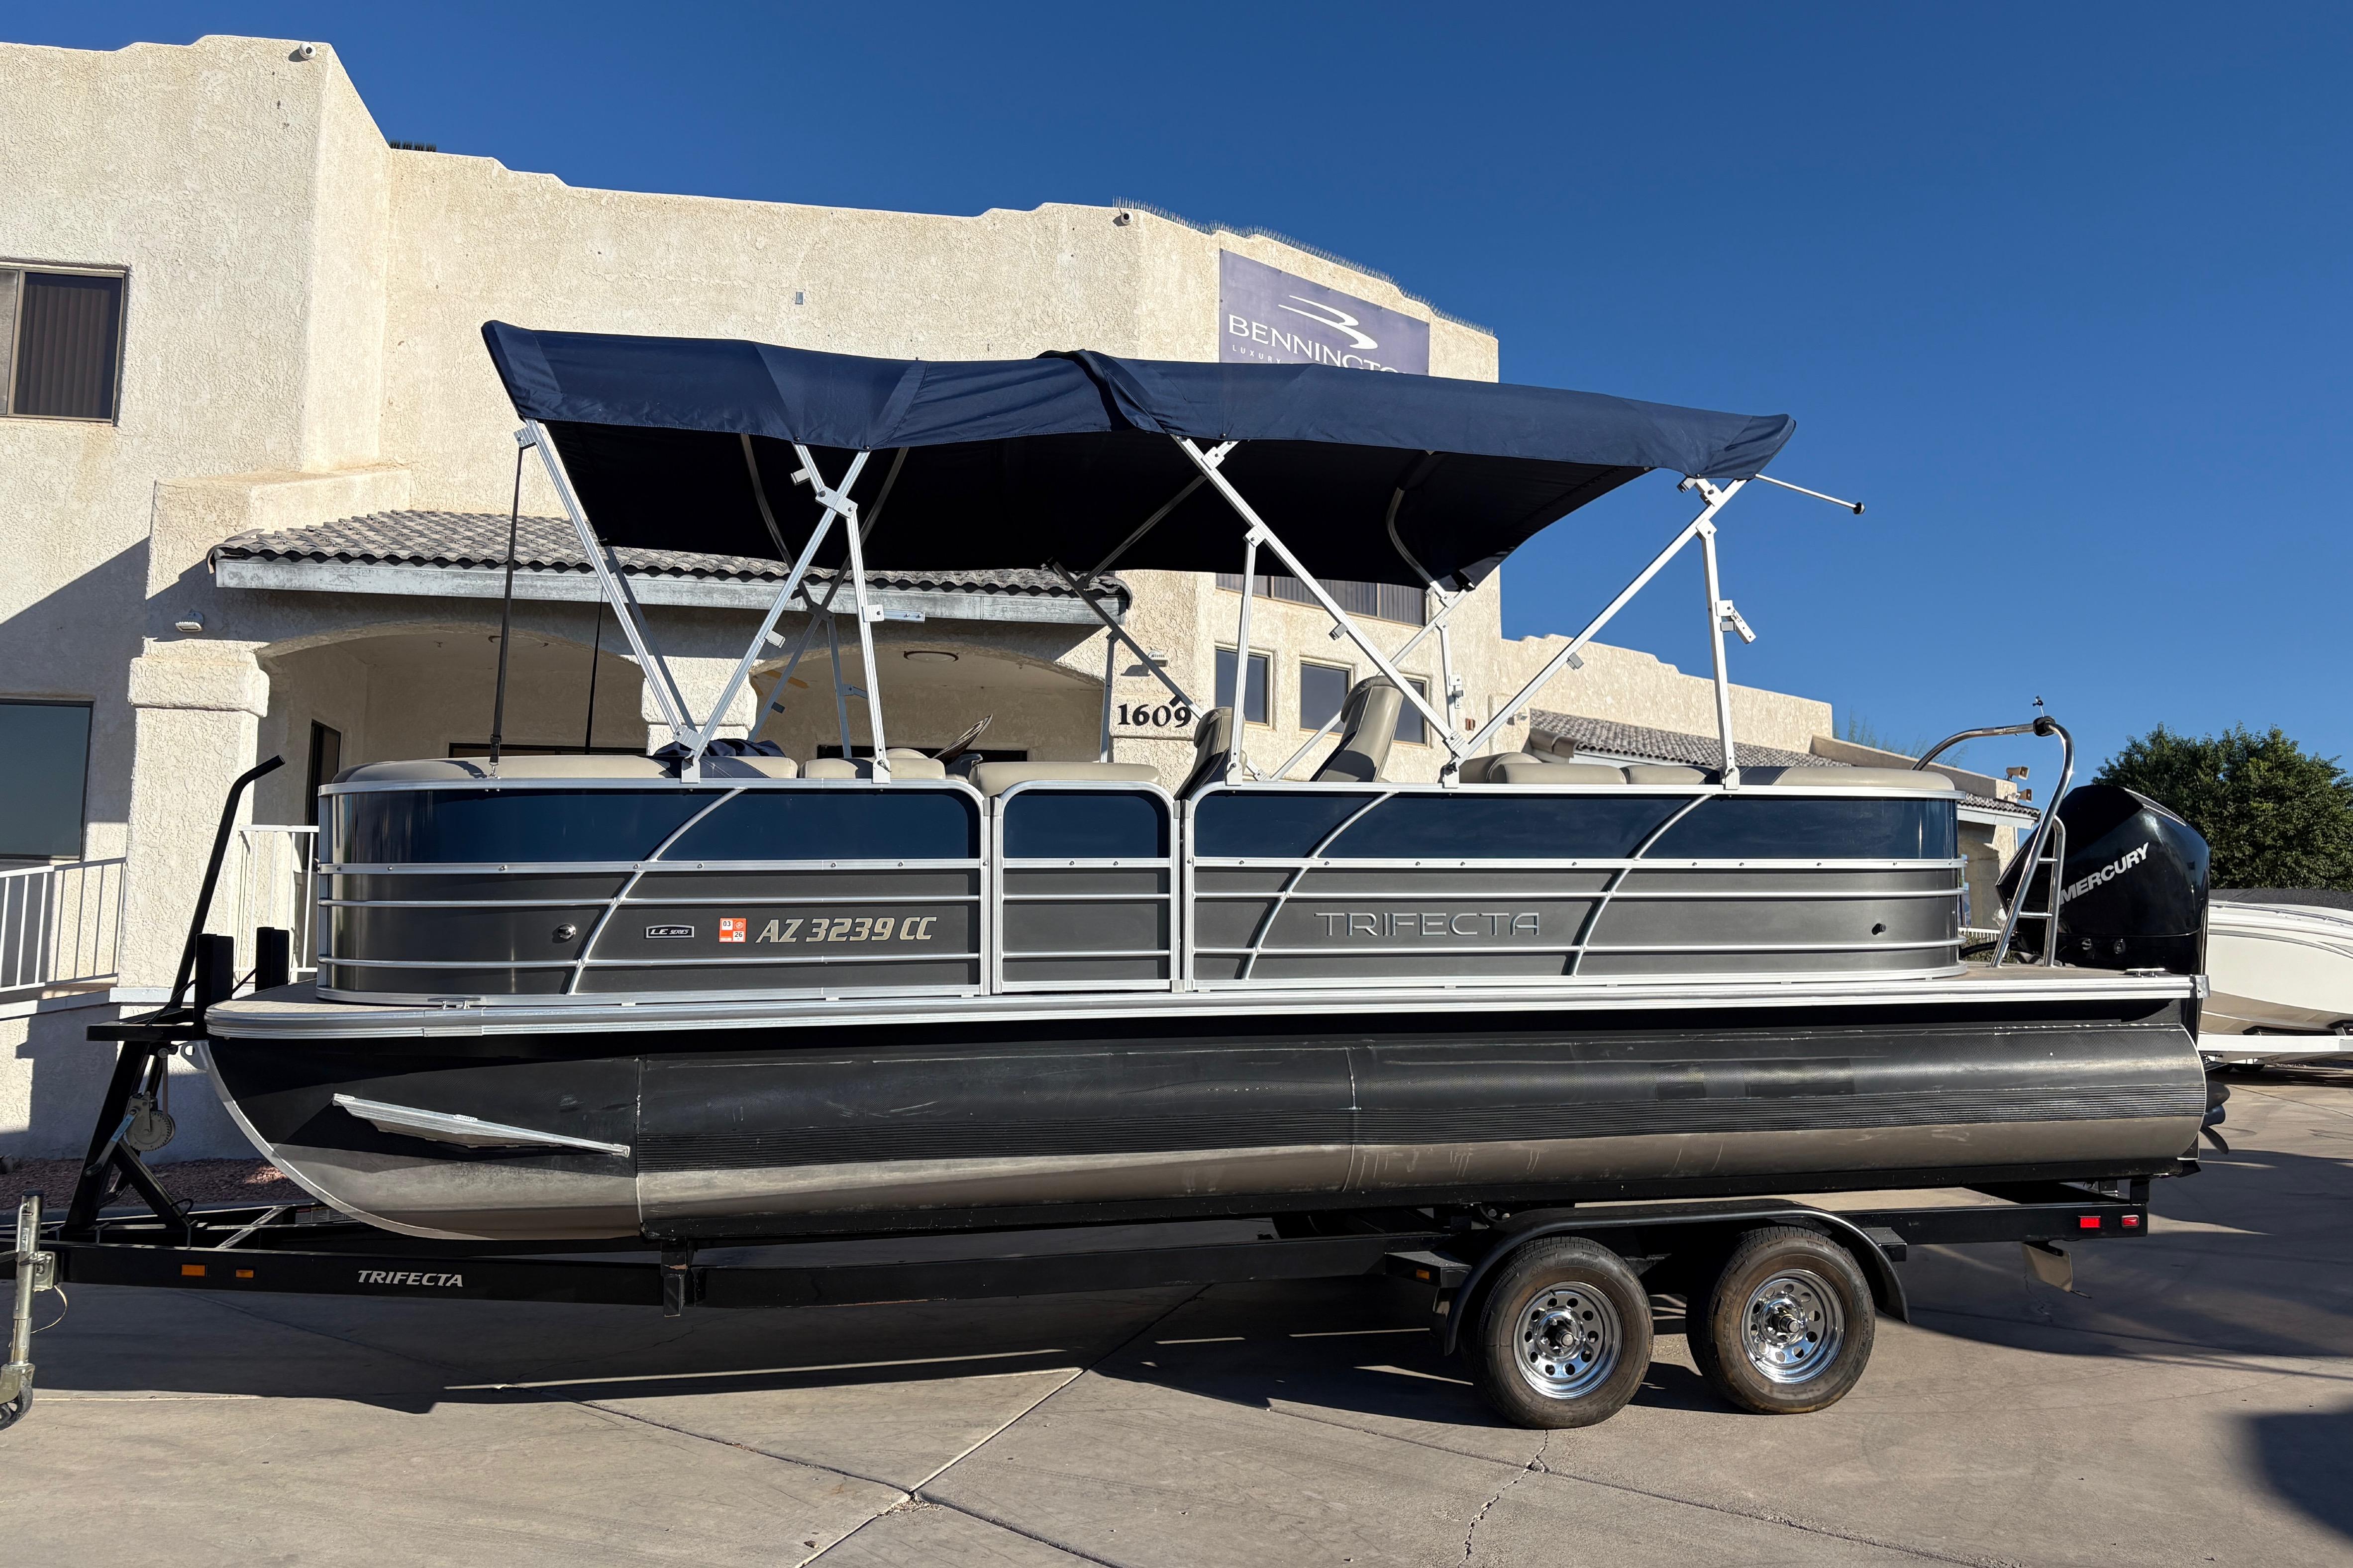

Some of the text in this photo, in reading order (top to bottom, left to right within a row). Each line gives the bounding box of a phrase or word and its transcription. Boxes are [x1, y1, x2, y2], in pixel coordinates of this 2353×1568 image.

[1232, 344, 1281, 364] LUXURY
[1118, 703, 1192, 728] 1609
[2059, 842, 2149, 905] MERCURY
[755, 916, 937, 943] AZ 3239 CC
[1314, 912, 1539, 936] TRIFECTA
[358, 1270, 464, 1287] TRIFECTA
